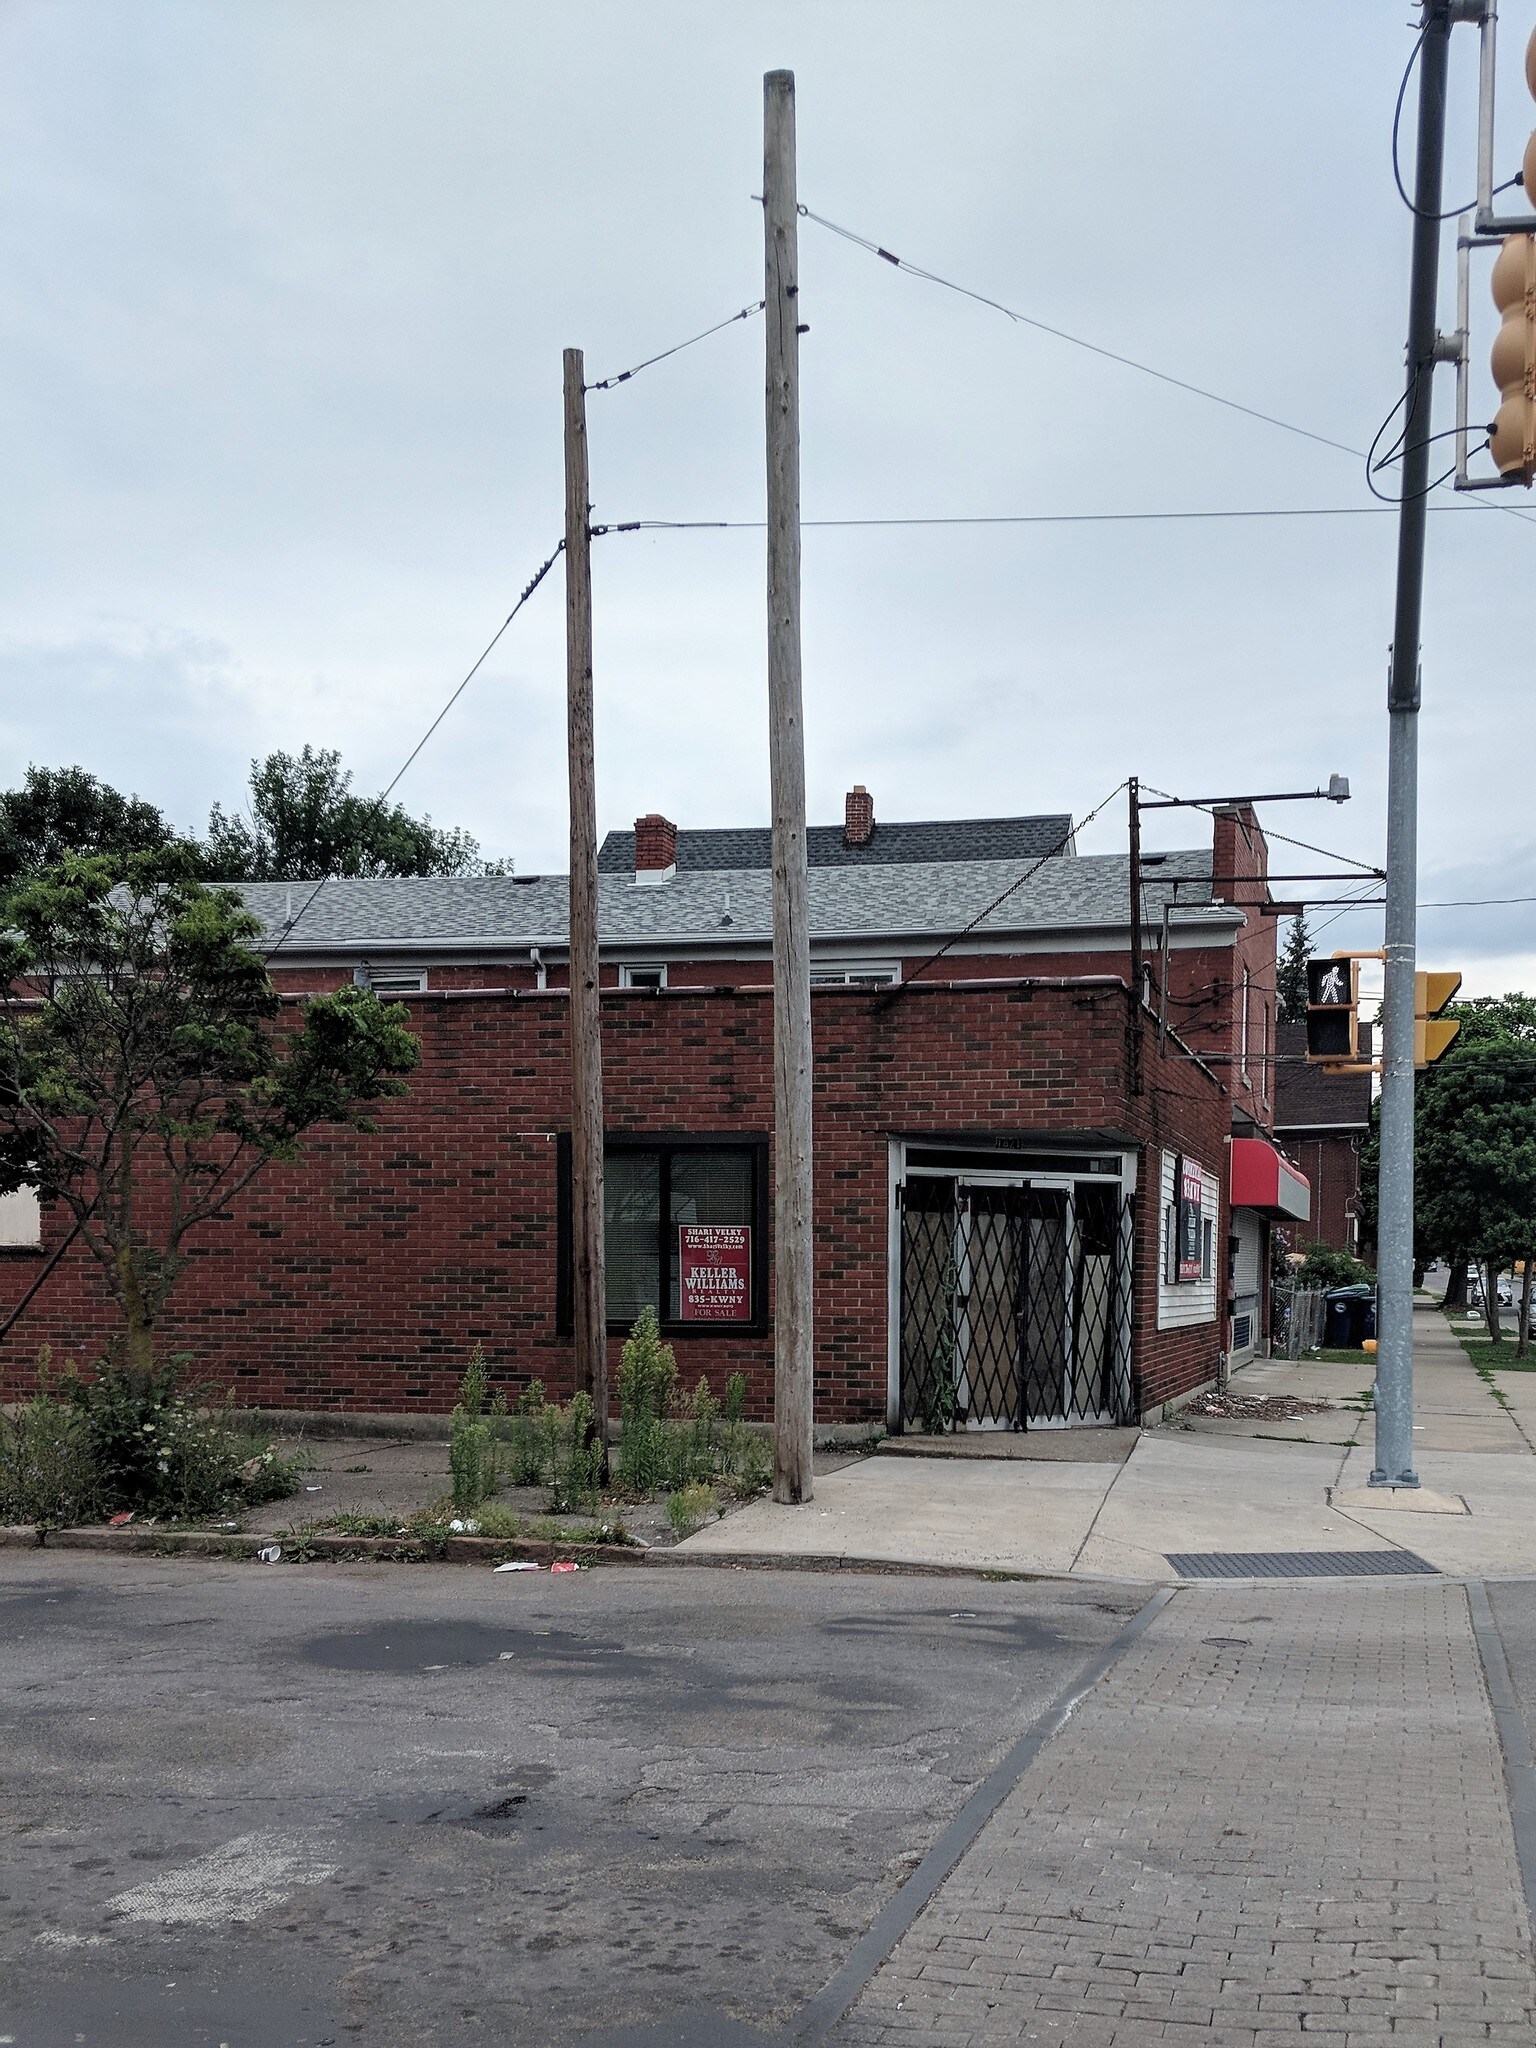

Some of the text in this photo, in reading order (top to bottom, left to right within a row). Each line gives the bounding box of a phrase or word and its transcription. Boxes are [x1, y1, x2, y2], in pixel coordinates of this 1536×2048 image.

[685, 1236, 746, 1244] 716-417-2529
[690, 1267, 737, 1278] KELLER
[685, 1278, 745, 1289] WILLIAMS
[688, 1295, 743, 1304] 835-KWNY
[714, 1309, 737, 1317] SALE
